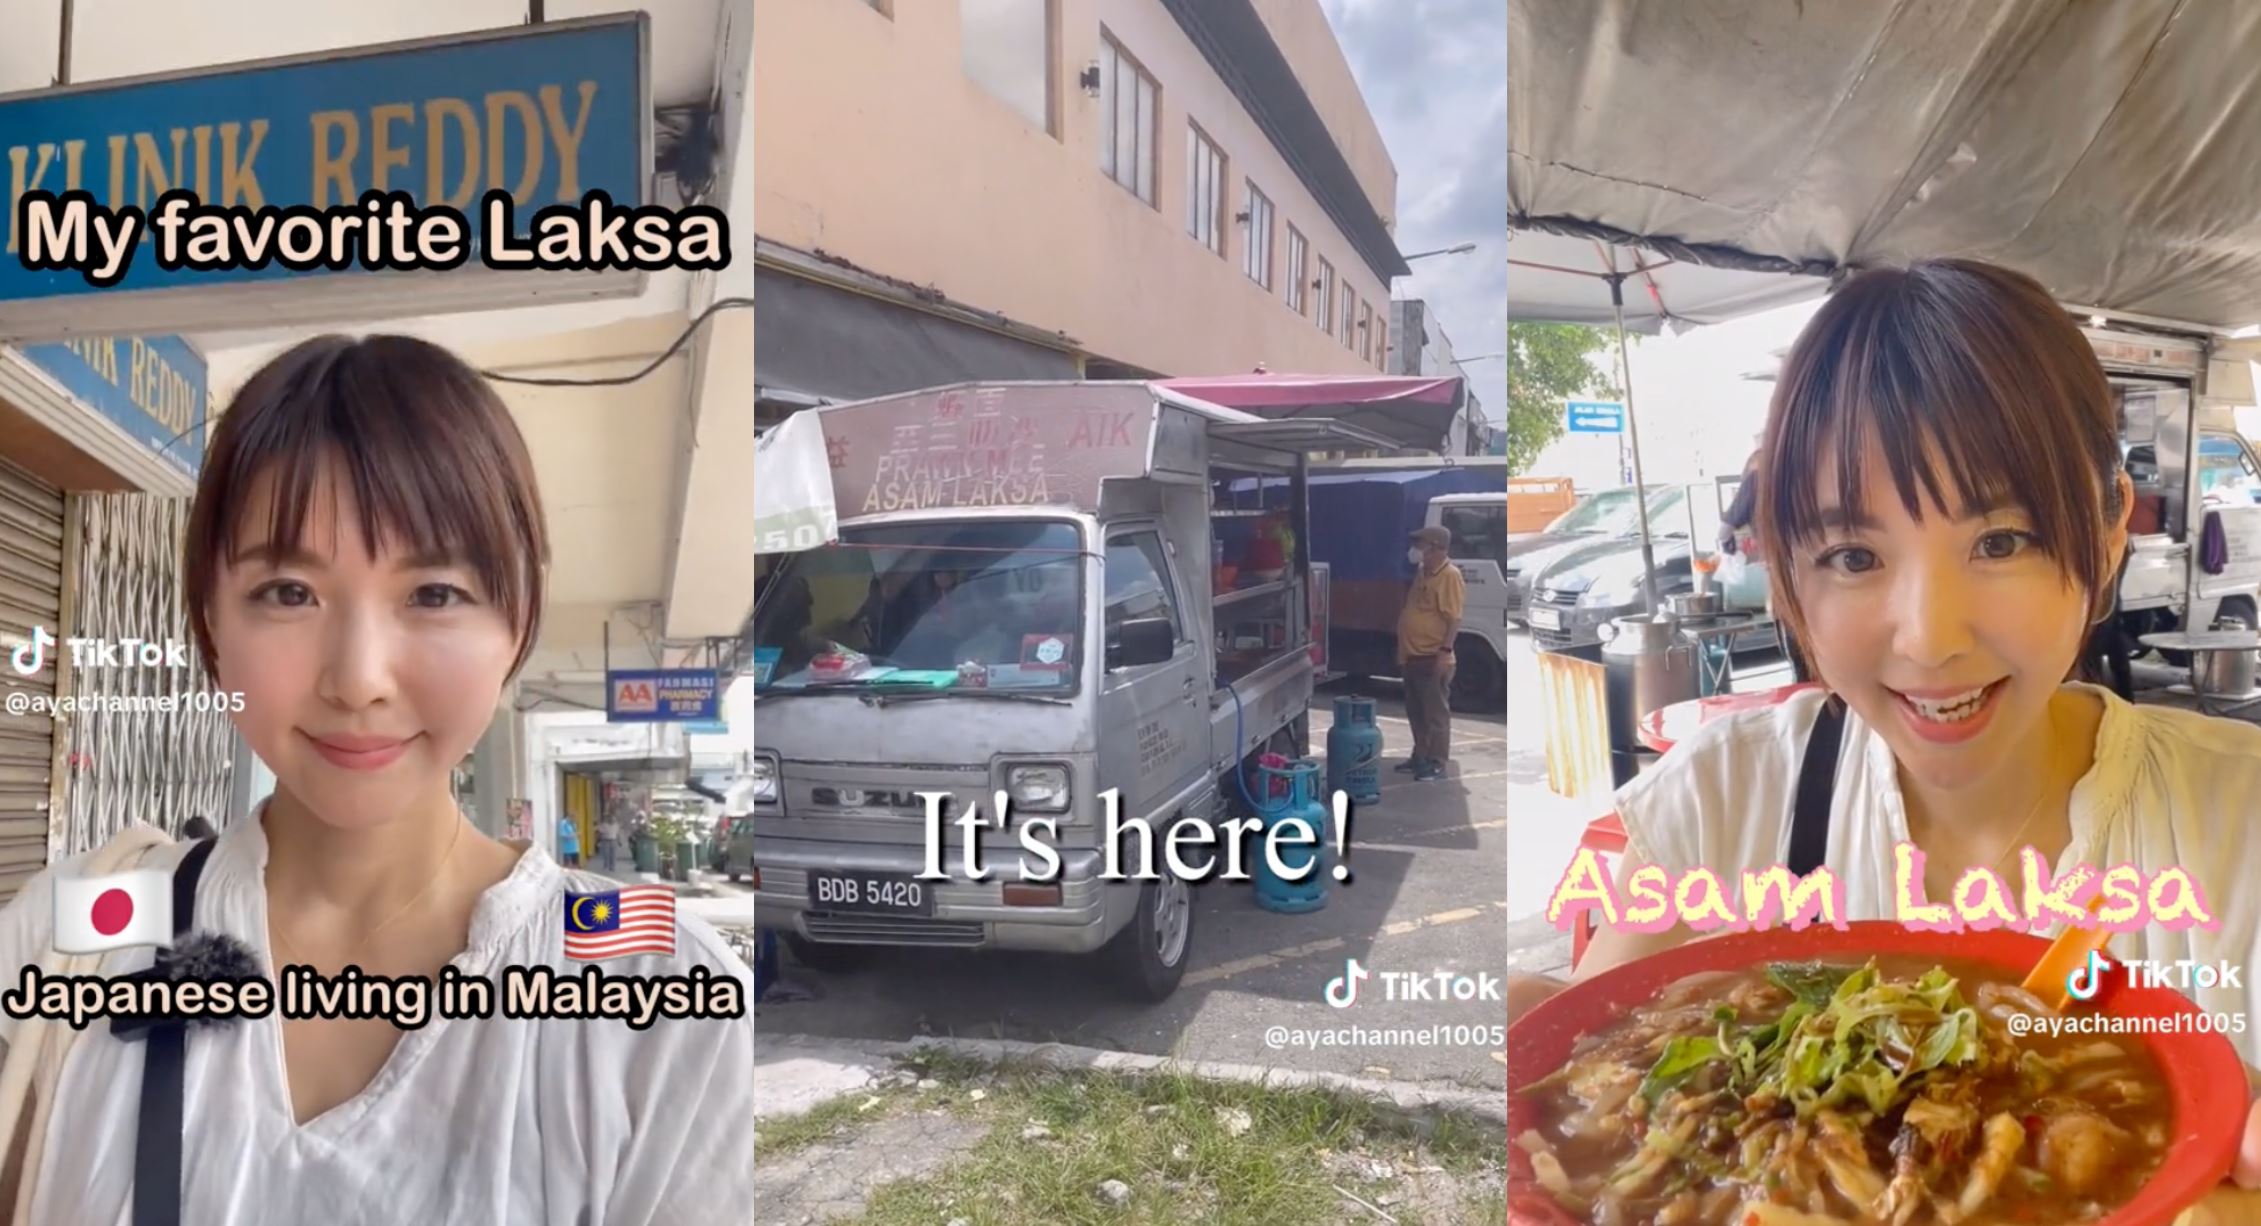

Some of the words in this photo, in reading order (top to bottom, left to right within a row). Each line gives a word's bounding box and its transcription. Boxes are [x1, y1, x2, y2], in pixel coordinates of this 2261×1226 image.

[310, 80, 598, 210] REDDY
[130, 335, 197, 447] REDDY
[1065, 411, 1135, 449] AIK
[862, 480, 942, 512] ASAM
[951, 474, 1049, 507] LAKSA
[817, 877, 859, 905] BDB
[866, 879, 922, 908] 5420
